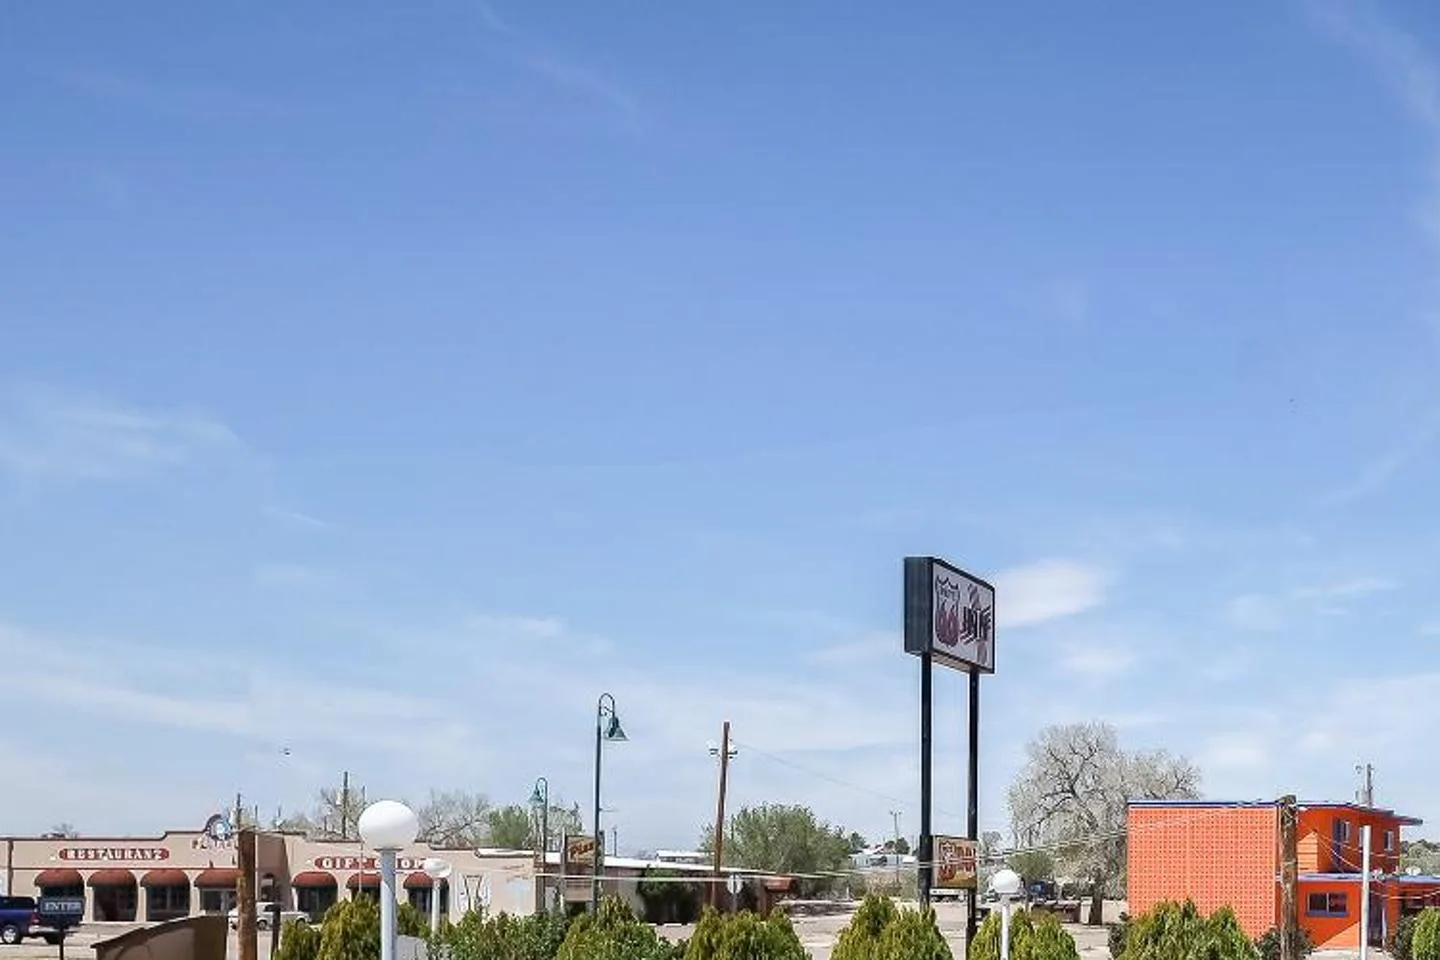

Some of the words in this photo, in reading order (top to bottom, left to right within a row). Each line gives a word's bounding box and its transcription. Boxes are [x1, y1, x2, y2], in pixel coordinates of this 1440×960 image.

[66, 848, 162, 860] RESTAURANT
[322, 858, 367, 869] GIFT
[43, 901, 82, 911] ENTER
